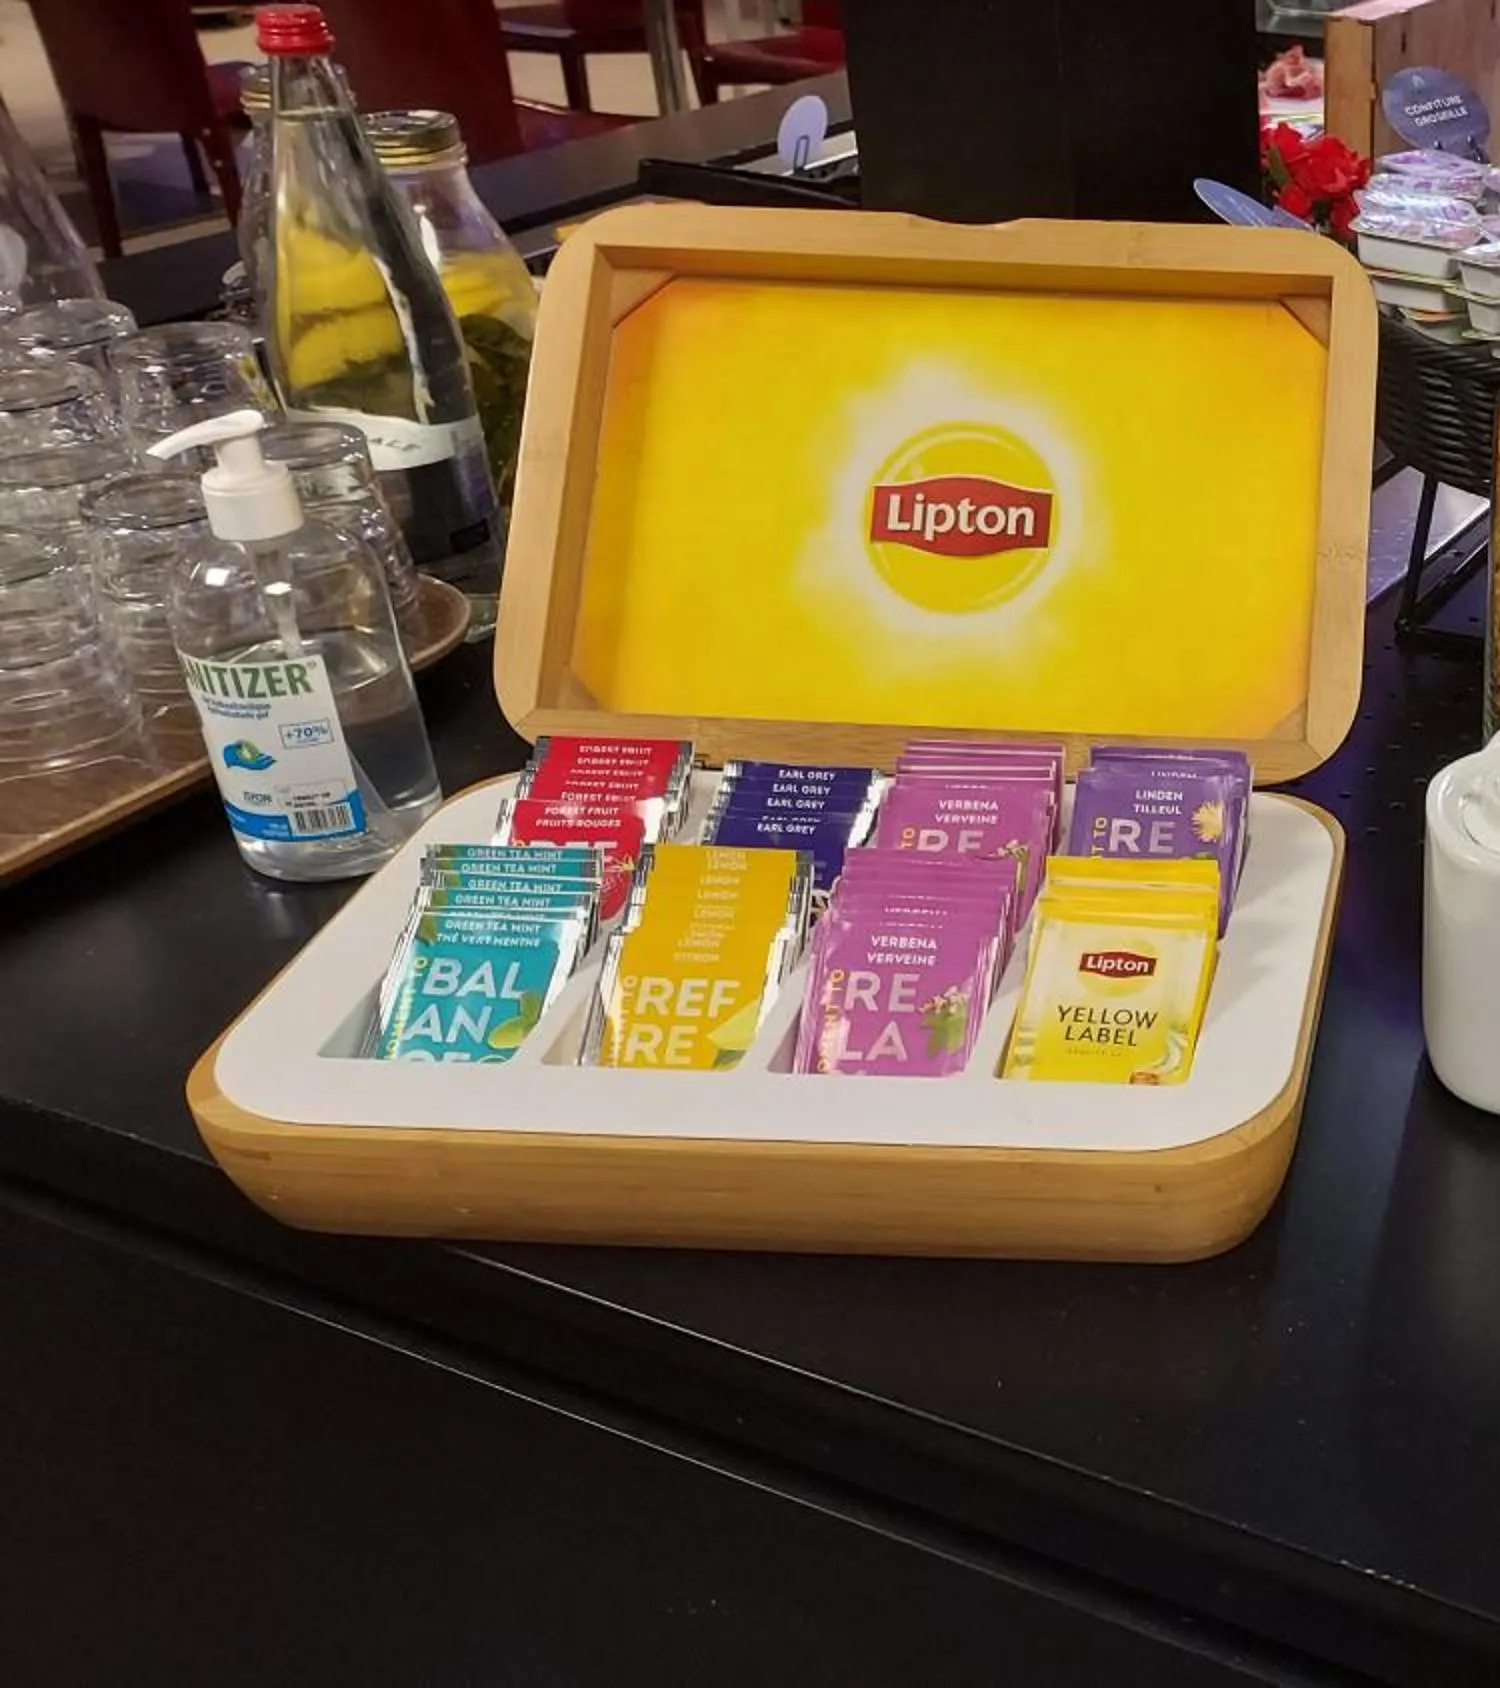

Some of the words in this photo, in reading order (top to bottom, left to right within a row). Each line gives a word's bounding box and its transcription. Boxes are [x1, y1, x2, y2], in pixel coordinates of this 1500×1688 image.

[1404, 95, 1463, 116] CONFITURE
[886, 493, 1035, 541] Lipton
[779, 769, 804, 779] EARL
[808, 771, 836, 781] GREY
[772, 784, 798, 793] EARL
[801, 785, 831, 795] GREY
[1135, 790, 1183, 801] LINDEN
[767, 798, 793, 808] EARL
[795, 800, 826, 810] GREY
[939, 800, 999, 811] VERBENA
[1133, 804, 1182, 815] TILLEUL
[935, 813, 999, 825] VERVEINE
[757, 823, 785, 833] EARL
[785, 825, 816, 835] GREY
[1108, 817, 1176, 854] RE
[467, 848, 506, 859] GREEN
[510, 849, 529, 859] TEA
[461, 863, 501, 873] GREEN
[504, 864, 525, 874] TEA
[527, 864, 557, 874] MINT
[467, 879, 506, 891] GREEN
[510, 881, 529, 892] TEA
[533, 883, 562, 893] MINT
[455, 894, 495, 904] GREEN
[498, 896, 519, 906] TEA
[521, 897, 551, 908] MINT
[445, 920, 487, 930] GREEN
[487, 921, 507, 931] TEA
[511, 923, 541, 934] MINT
[871, 935, 938, 950] VERBENA
[867, 953, 937, 966] VERVEINE
[1086, 955, 1150, 975] Lipton
[421, 957, 523, 999] BAL
[635, 976, 741, 1019] REF
[844, 970, 921, 1014] RE
[403, 1003, 492, 1043] AN
[1056, 1004, 1159, 1030] YELLOW
[838, 1020, 908, 1062] LA
[1064, 1025, 1138, 1047] LABEL
[623, 1022, 698, 1066] RE
